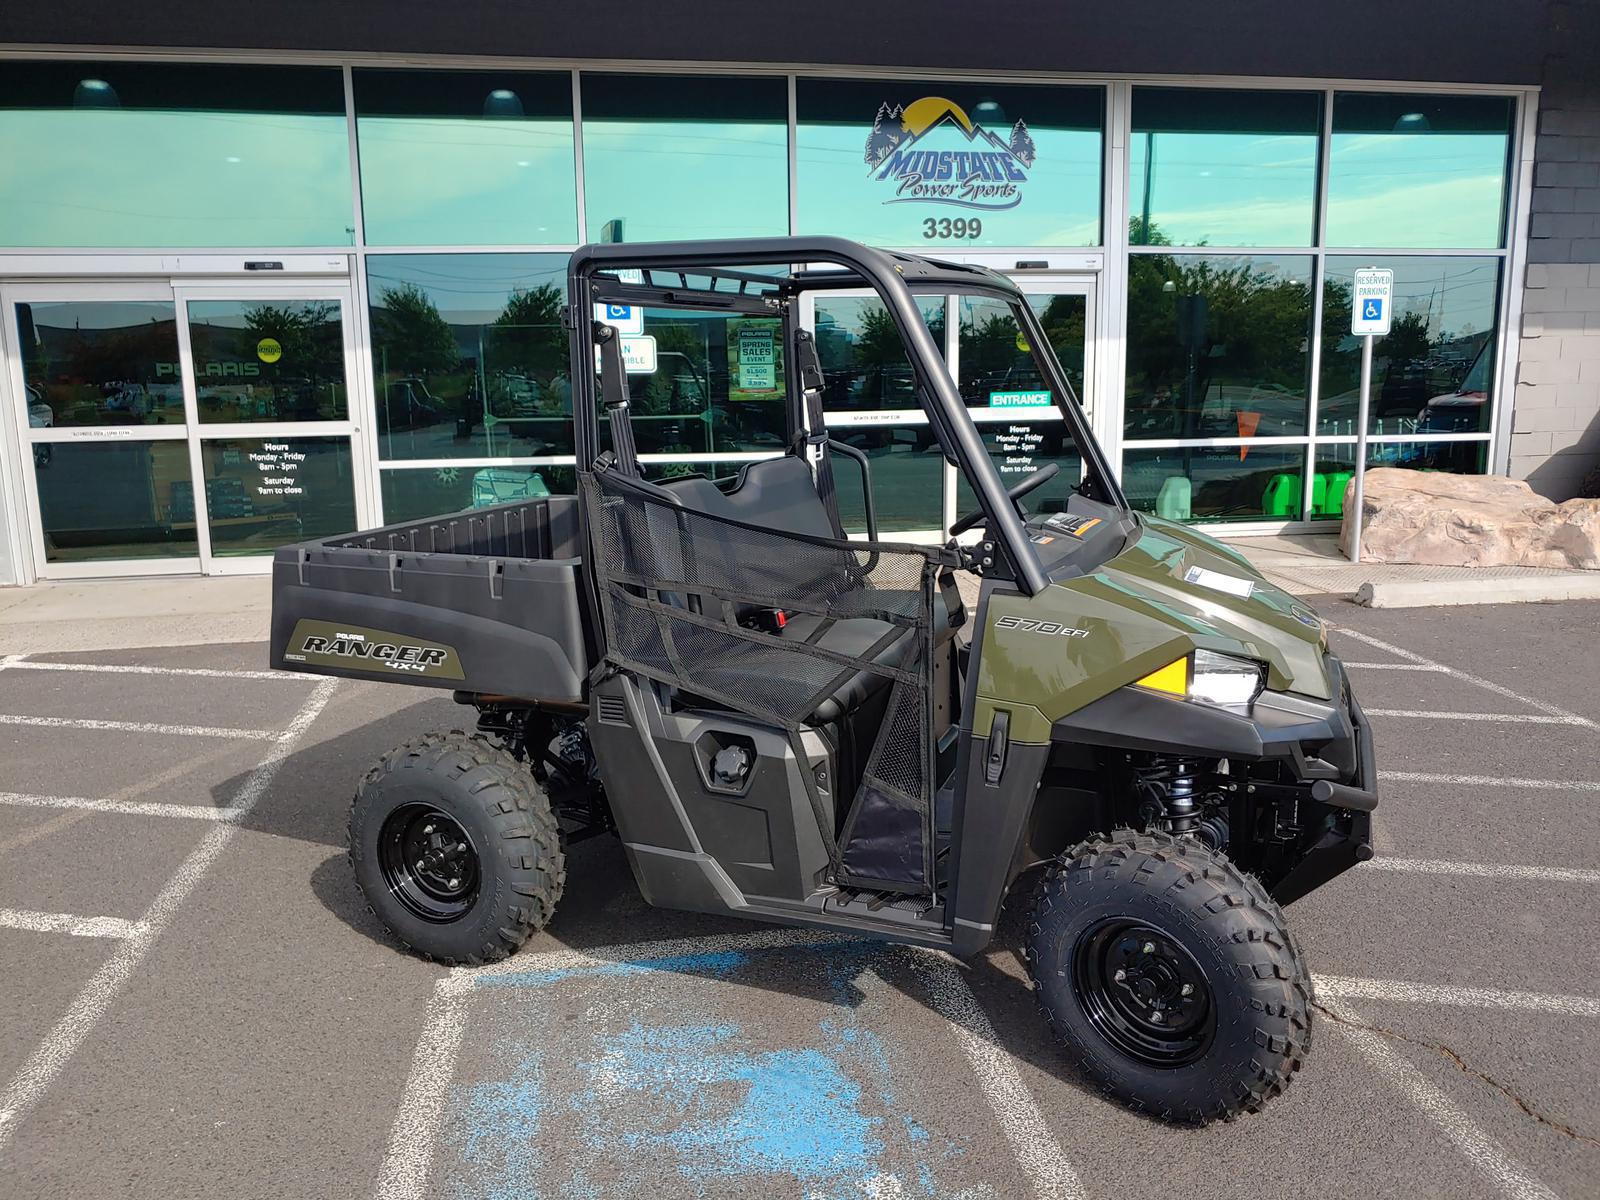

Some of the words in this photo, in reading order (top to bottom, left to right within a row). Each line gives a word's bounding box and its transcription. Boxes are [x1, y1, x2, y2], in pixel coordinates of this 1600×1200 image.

[875, 150, 1027, 182] MIDSTATE
[896, 173, 959, 197] Power
[958, 173, 1017, 201] Sports
[922, 217, 982, 239] 3399
[1357, 276, 1390, 285] RESERVED
[1358, 287, 1388, 296] PARKING
[992, 393, 1048, 406] ENTRANCE
[1009, 425, 1030, 433] Hours
[995, 434, 1020, 443] Monday
[1024, 433, 1044, 443] Friday
[264, 443, 289, 451] Hours
[1003, 443, 1017, 451] 8am
[1021, 443, 1036, 452] 5pm
[249, 453, 278, 462] Monday
[284, 452, 306, 462] Friday
[1006, 456, 1032, 465] Saturday
[259, 462, 275, 471] 8am
[281, 462, 298, 472] 5pm
[1000, 465, 1013, 473] 9am
[1014, 465, 1021, 473] to
[1022, 464, 1038, 472] close
[264, 476, 295, 486] Saturday
[257, 486, 274, 495] 9am
[274, 487, 283, 495] to
[284, 486, 303, 494] close
[994, 615, 1063, 635] 570
[1060, 627, 1090, 638] EFI
[336, 632, 365, 641] POLARIS
[302, 635, 448, 667] RANGER
